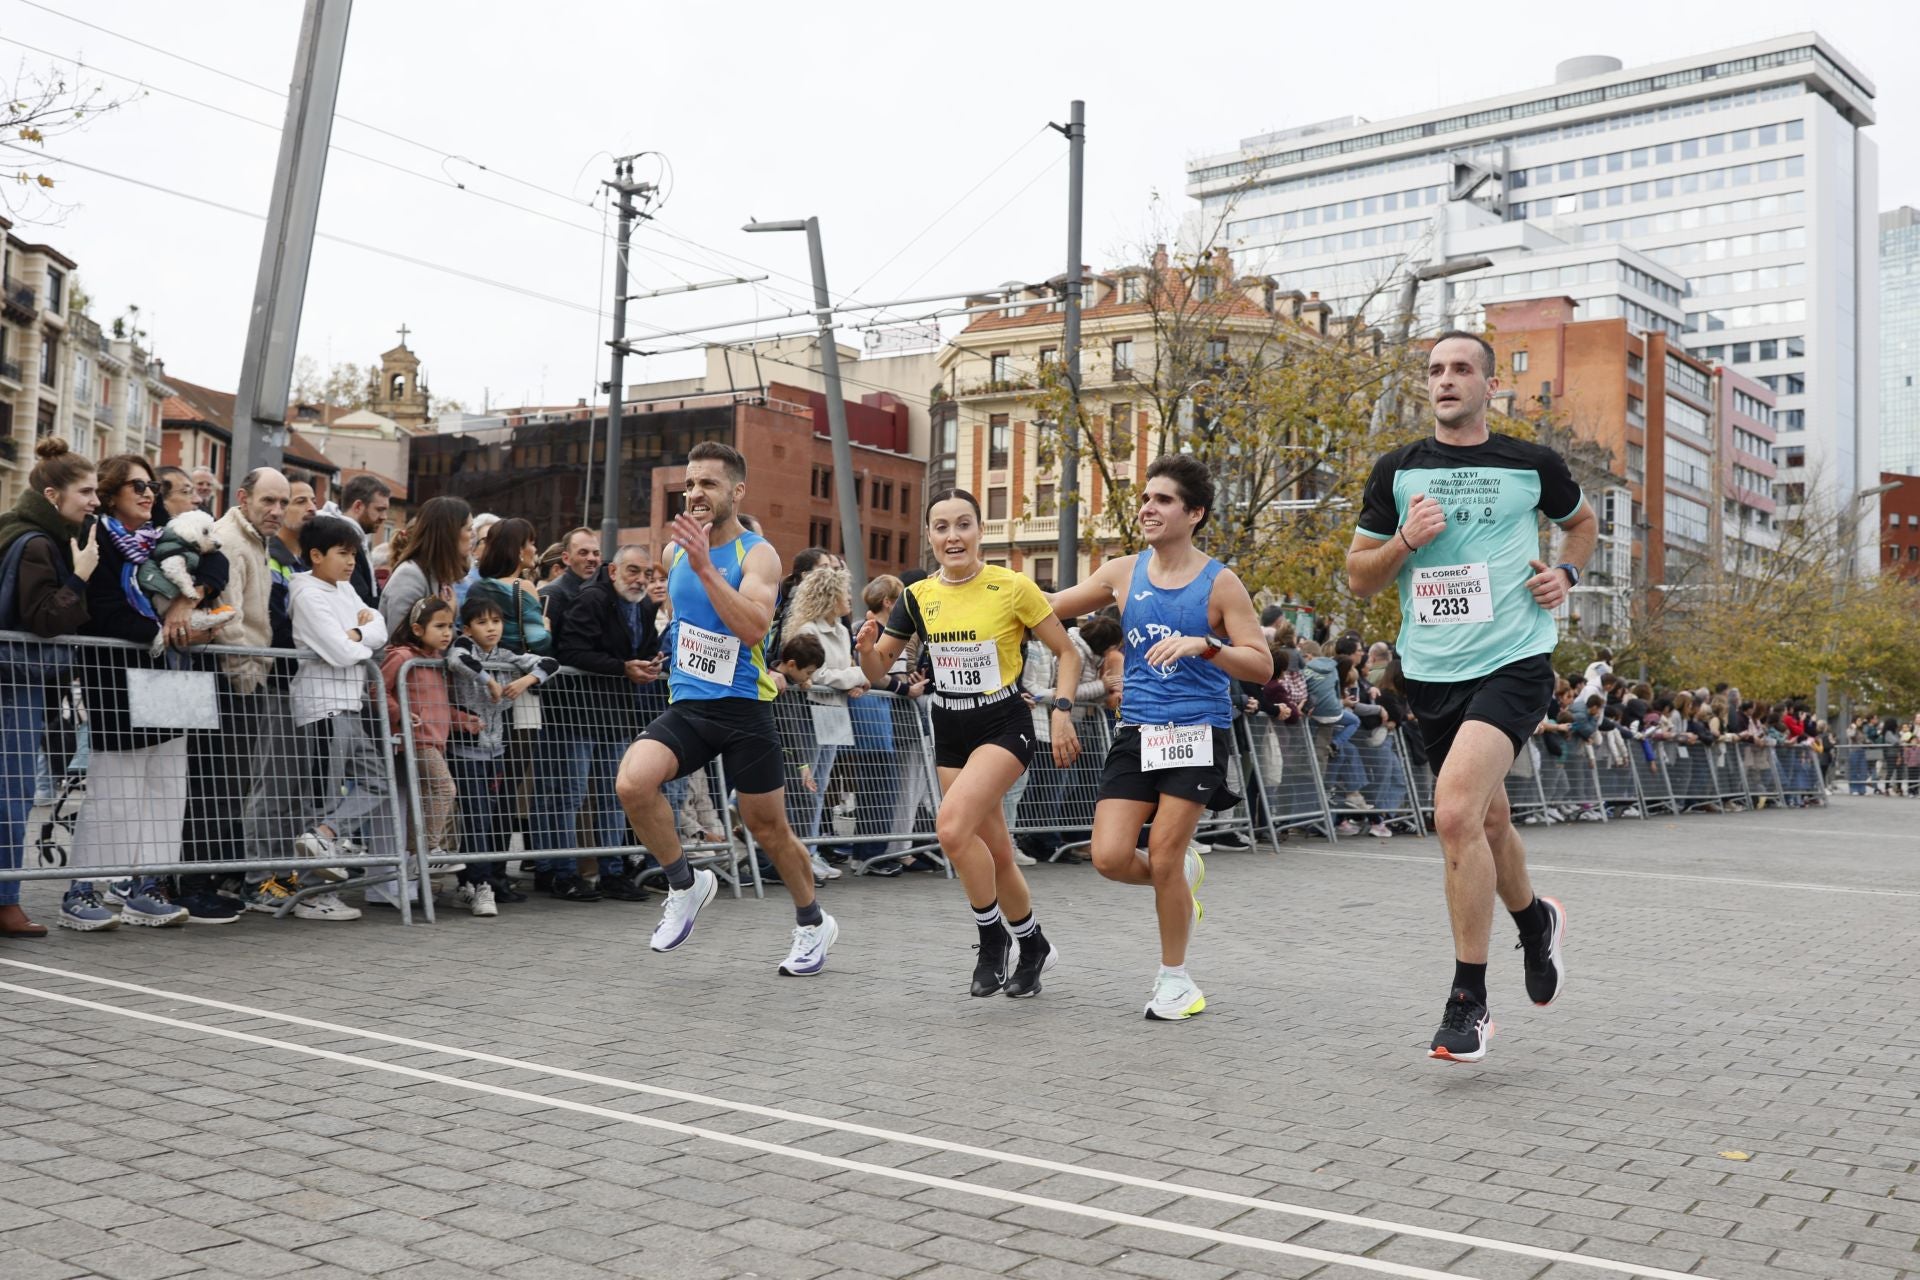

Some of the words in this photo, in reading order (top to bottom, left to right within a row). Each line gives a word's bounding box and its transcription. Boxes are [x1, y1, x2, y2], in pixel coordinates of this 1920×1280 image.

[1451, 471, 1479, 479] XXXVI
[1466, 478, 1501, 486] LASTERKETA
[1428, 487, 1454, 495] CARRERA
[1454, 487, 1501, 495] INTERNACIONAL
[1472, 497, 1477, 505] A
[1432, 569, 1468, 578] CORREO
[1415, 583, 1446, 597] XXXVI
[1447, 579, 1481, 589] SANTURCE
[1447, 586, 1482, 595] BILBAO
[1431, 597, 1470, 616] 2333
[1427, 615, 1461, 624] kutxabank
[688, 628, 696, 636] EL
[696, 631, 724, 644] CORREO
[927, 630, 977, 643] RUNNING
[1127, 627, 1147, 648] EL
[680, 635, 704, 653] XXXVI
[703, 644, 731, 655] SANTURCE
[951, 645, 980, 653] CORREO
[702, 649, 730, 660] BILBAO
[687, 652, 717, 674] 2766
[936, 656, 961, 668] XXXVI
[962, 660, 991, 668] BILBAO
[949, 669, 981, 685] 1138
[945, 696, 975, 711] PUMA
[1176, 735, 1205, 744] BILBAO
[1160, 744, 1194, 761] 1866
